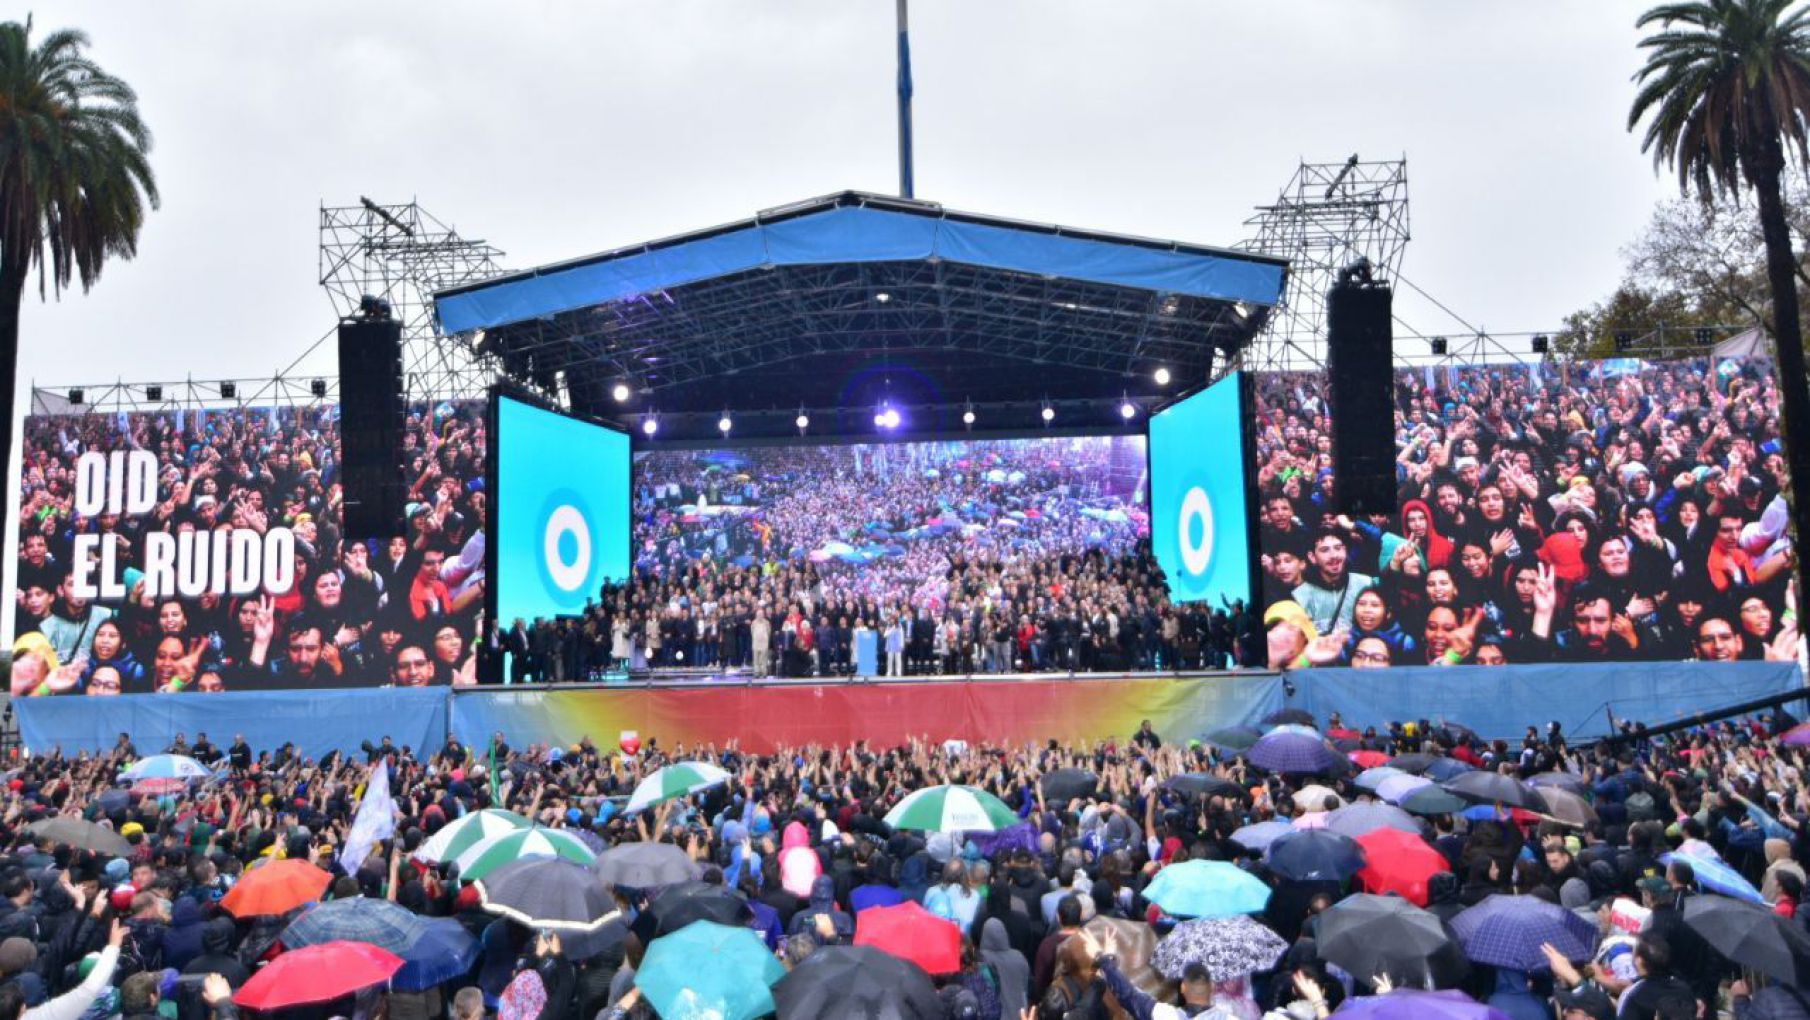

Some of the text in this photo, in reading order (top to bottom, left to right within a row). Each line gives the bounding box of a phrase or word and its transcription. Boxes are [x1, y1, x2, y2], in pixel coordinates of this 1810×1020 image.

[75, 450, 158, 516] OID
[73, 527, 295, 598] EL RUIDO
